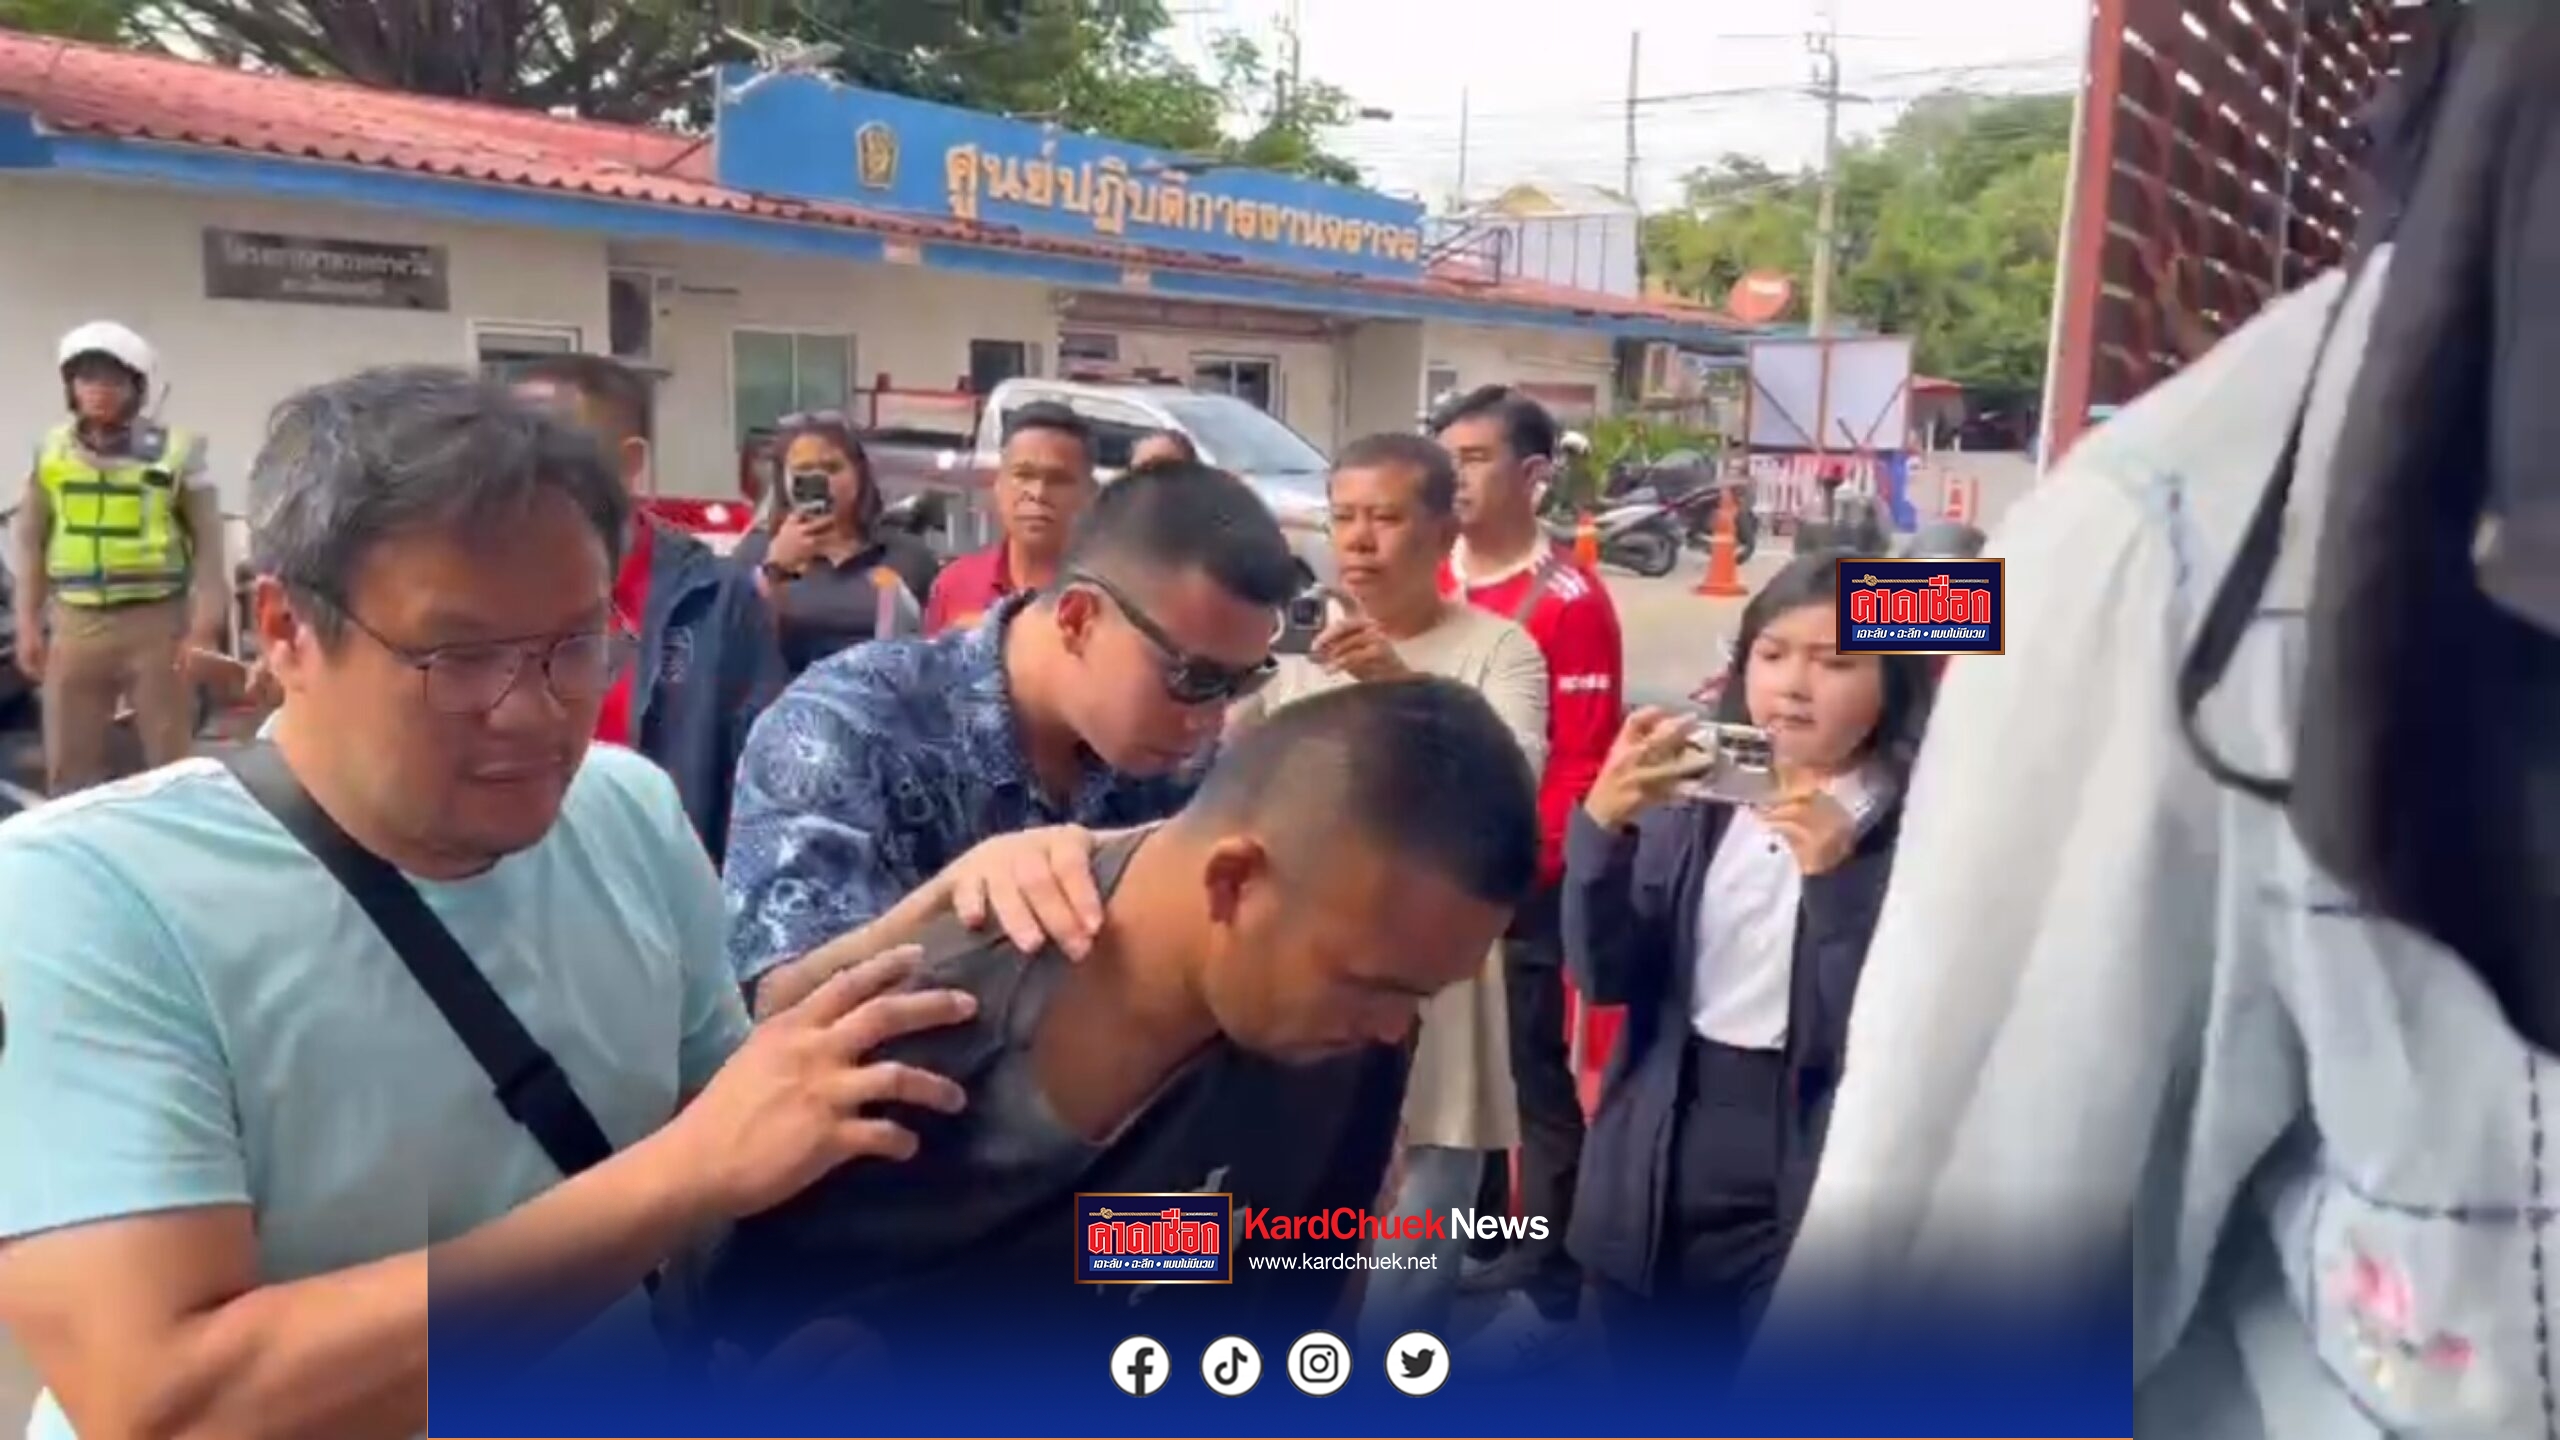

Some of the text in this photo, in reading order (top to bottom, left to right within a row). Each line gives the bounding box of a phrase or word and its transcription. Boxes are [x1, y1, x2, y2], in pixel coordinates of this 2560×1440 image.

[945, 136, 1420, 263] ศูนย์ปฏิบัติการงานจราจร
